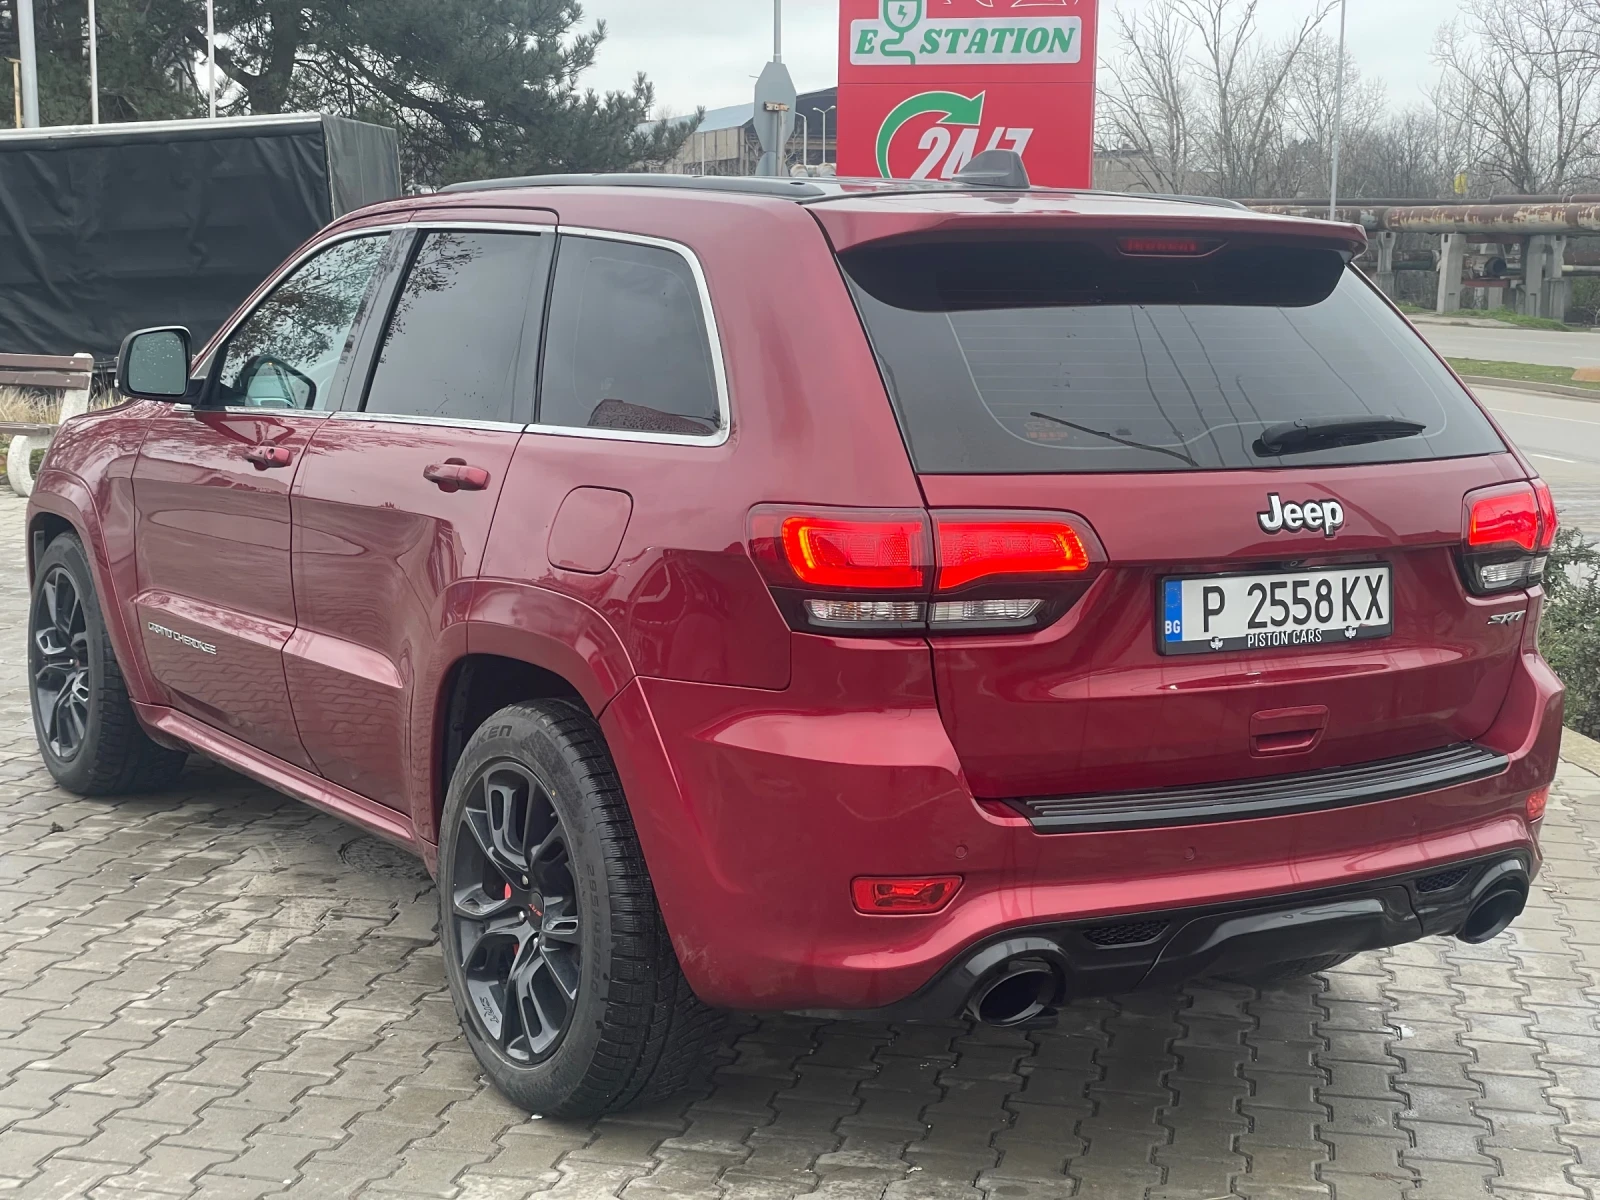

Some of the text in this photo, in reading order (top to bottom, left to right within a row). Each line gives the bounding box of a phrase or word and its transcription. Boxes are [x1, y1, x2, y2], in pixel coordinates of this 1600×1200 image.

[854, 27, 1076, 55] E STATION
[1257, 493, 1345, 538] Jeep
[1203, 574, 1384, 633] P 2558 KX
[1165, 620, 1181, 635] BG
[1246, 629, 1323, 648] PISTON CARS
[479, 996, 500, 1025] SRT
